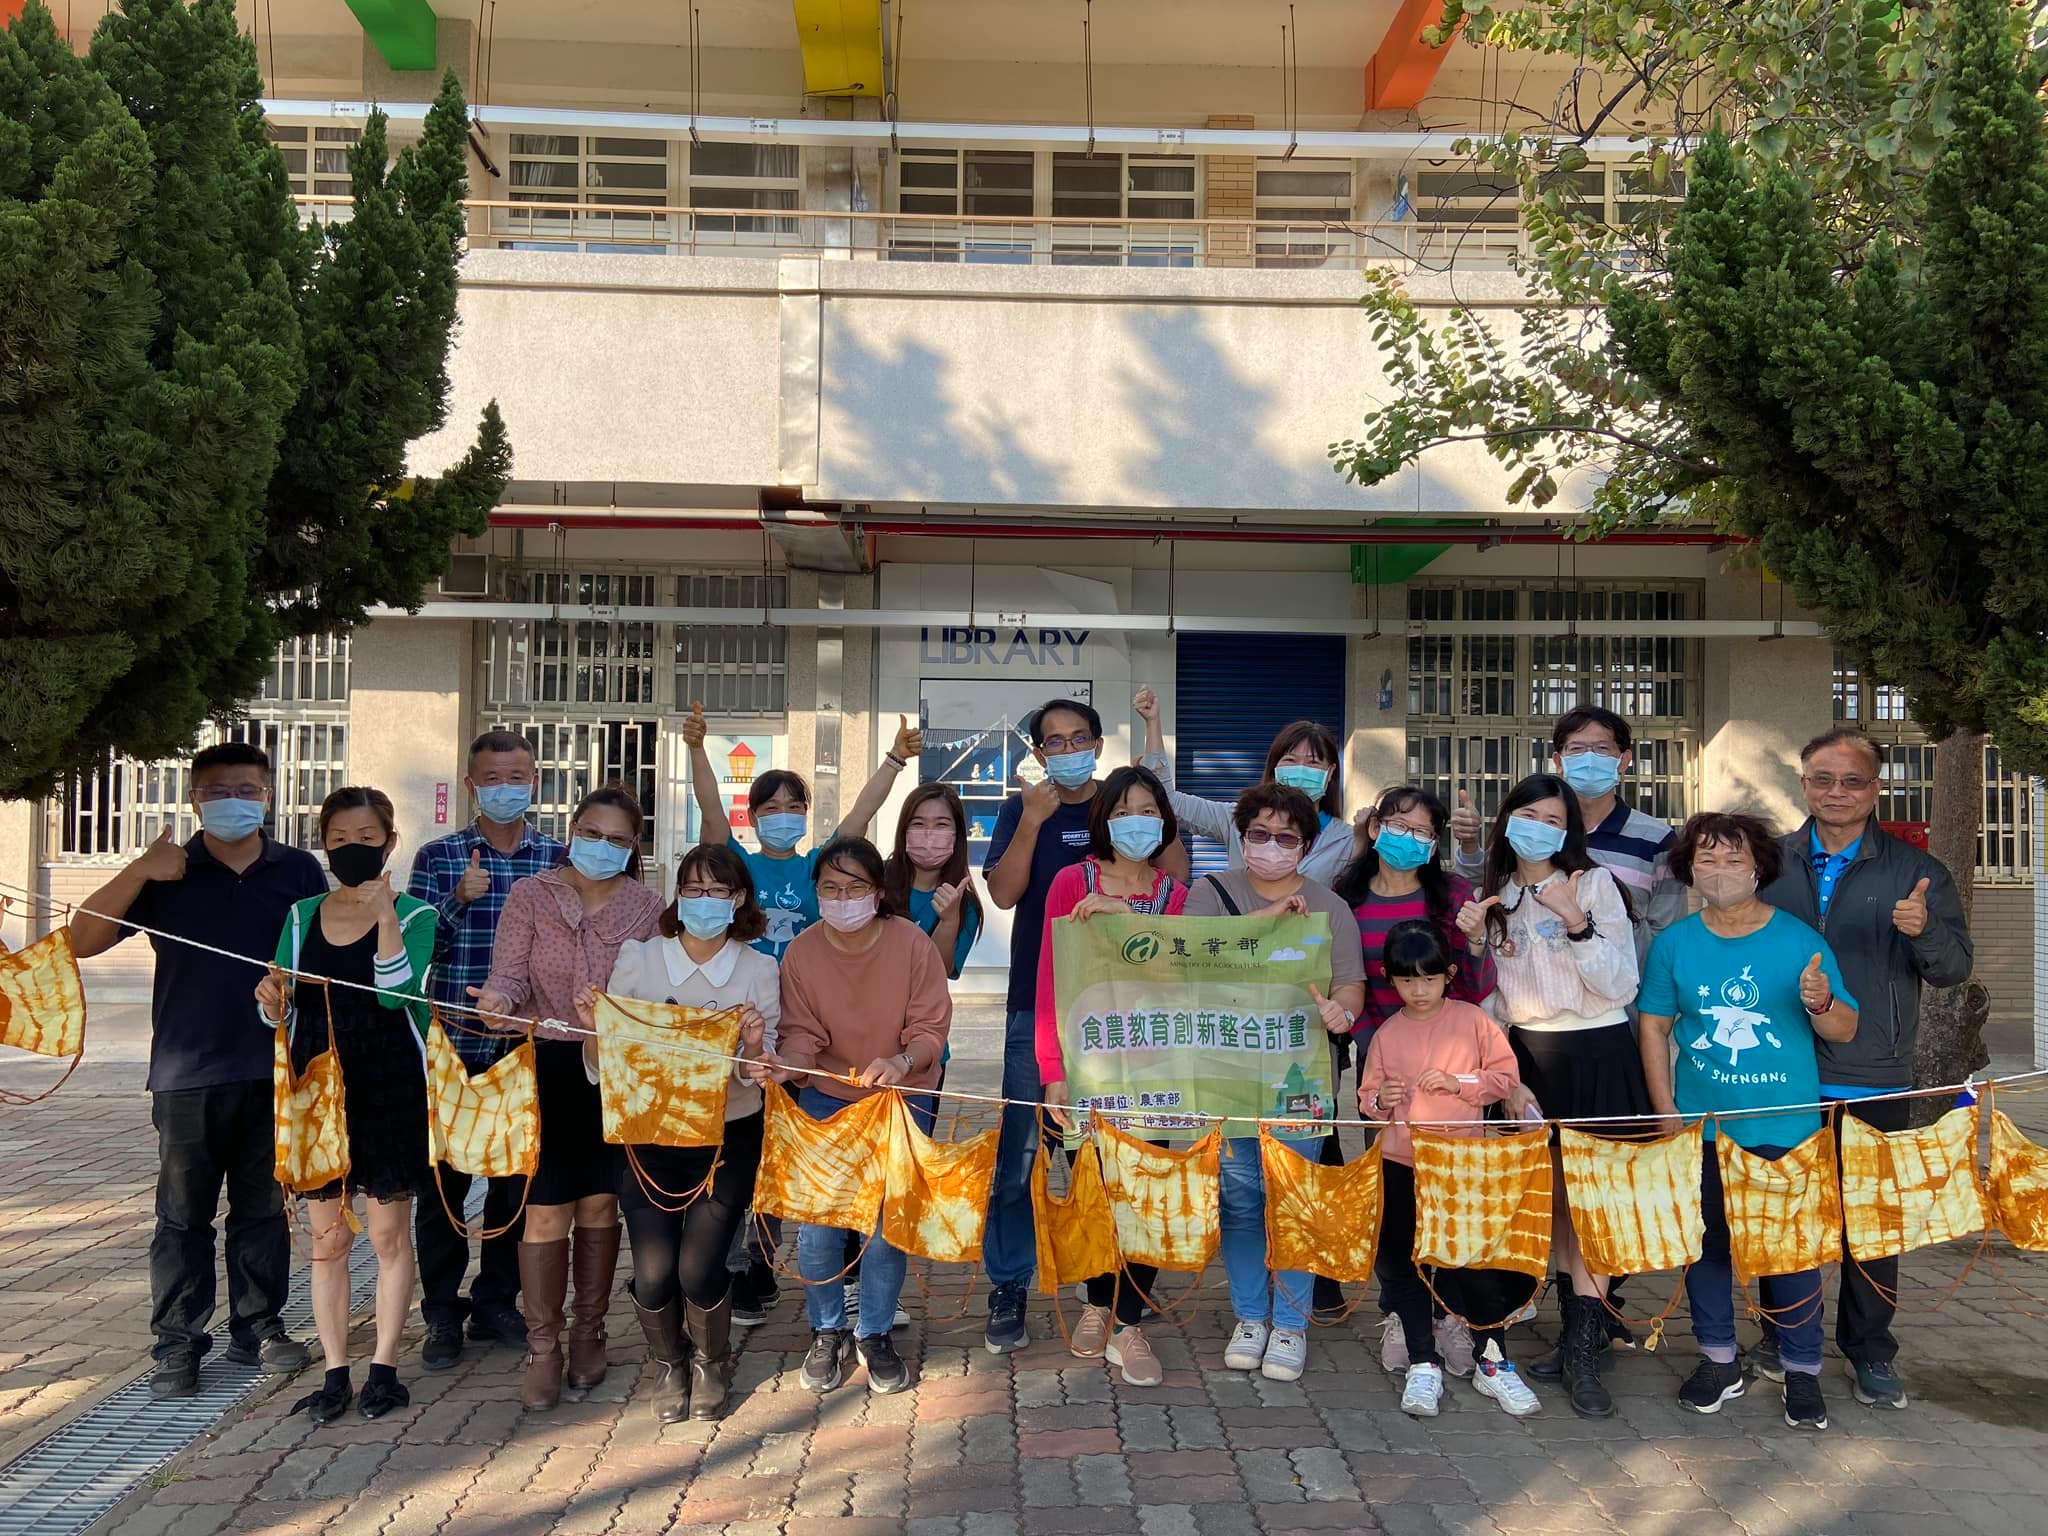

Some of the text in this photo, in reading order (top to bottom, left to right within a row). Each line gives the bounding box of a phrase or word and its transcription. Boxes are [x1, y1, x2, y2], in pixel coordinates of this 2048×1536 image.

[919, 627, 1090, 666] LIBRARY
[1169, 936, 1259, 957] 農業部
[1081, 1011, 1306, 1050] 食農教育創新整合計畫
[1711, 1069, 1788, 1085] SHENGANG
